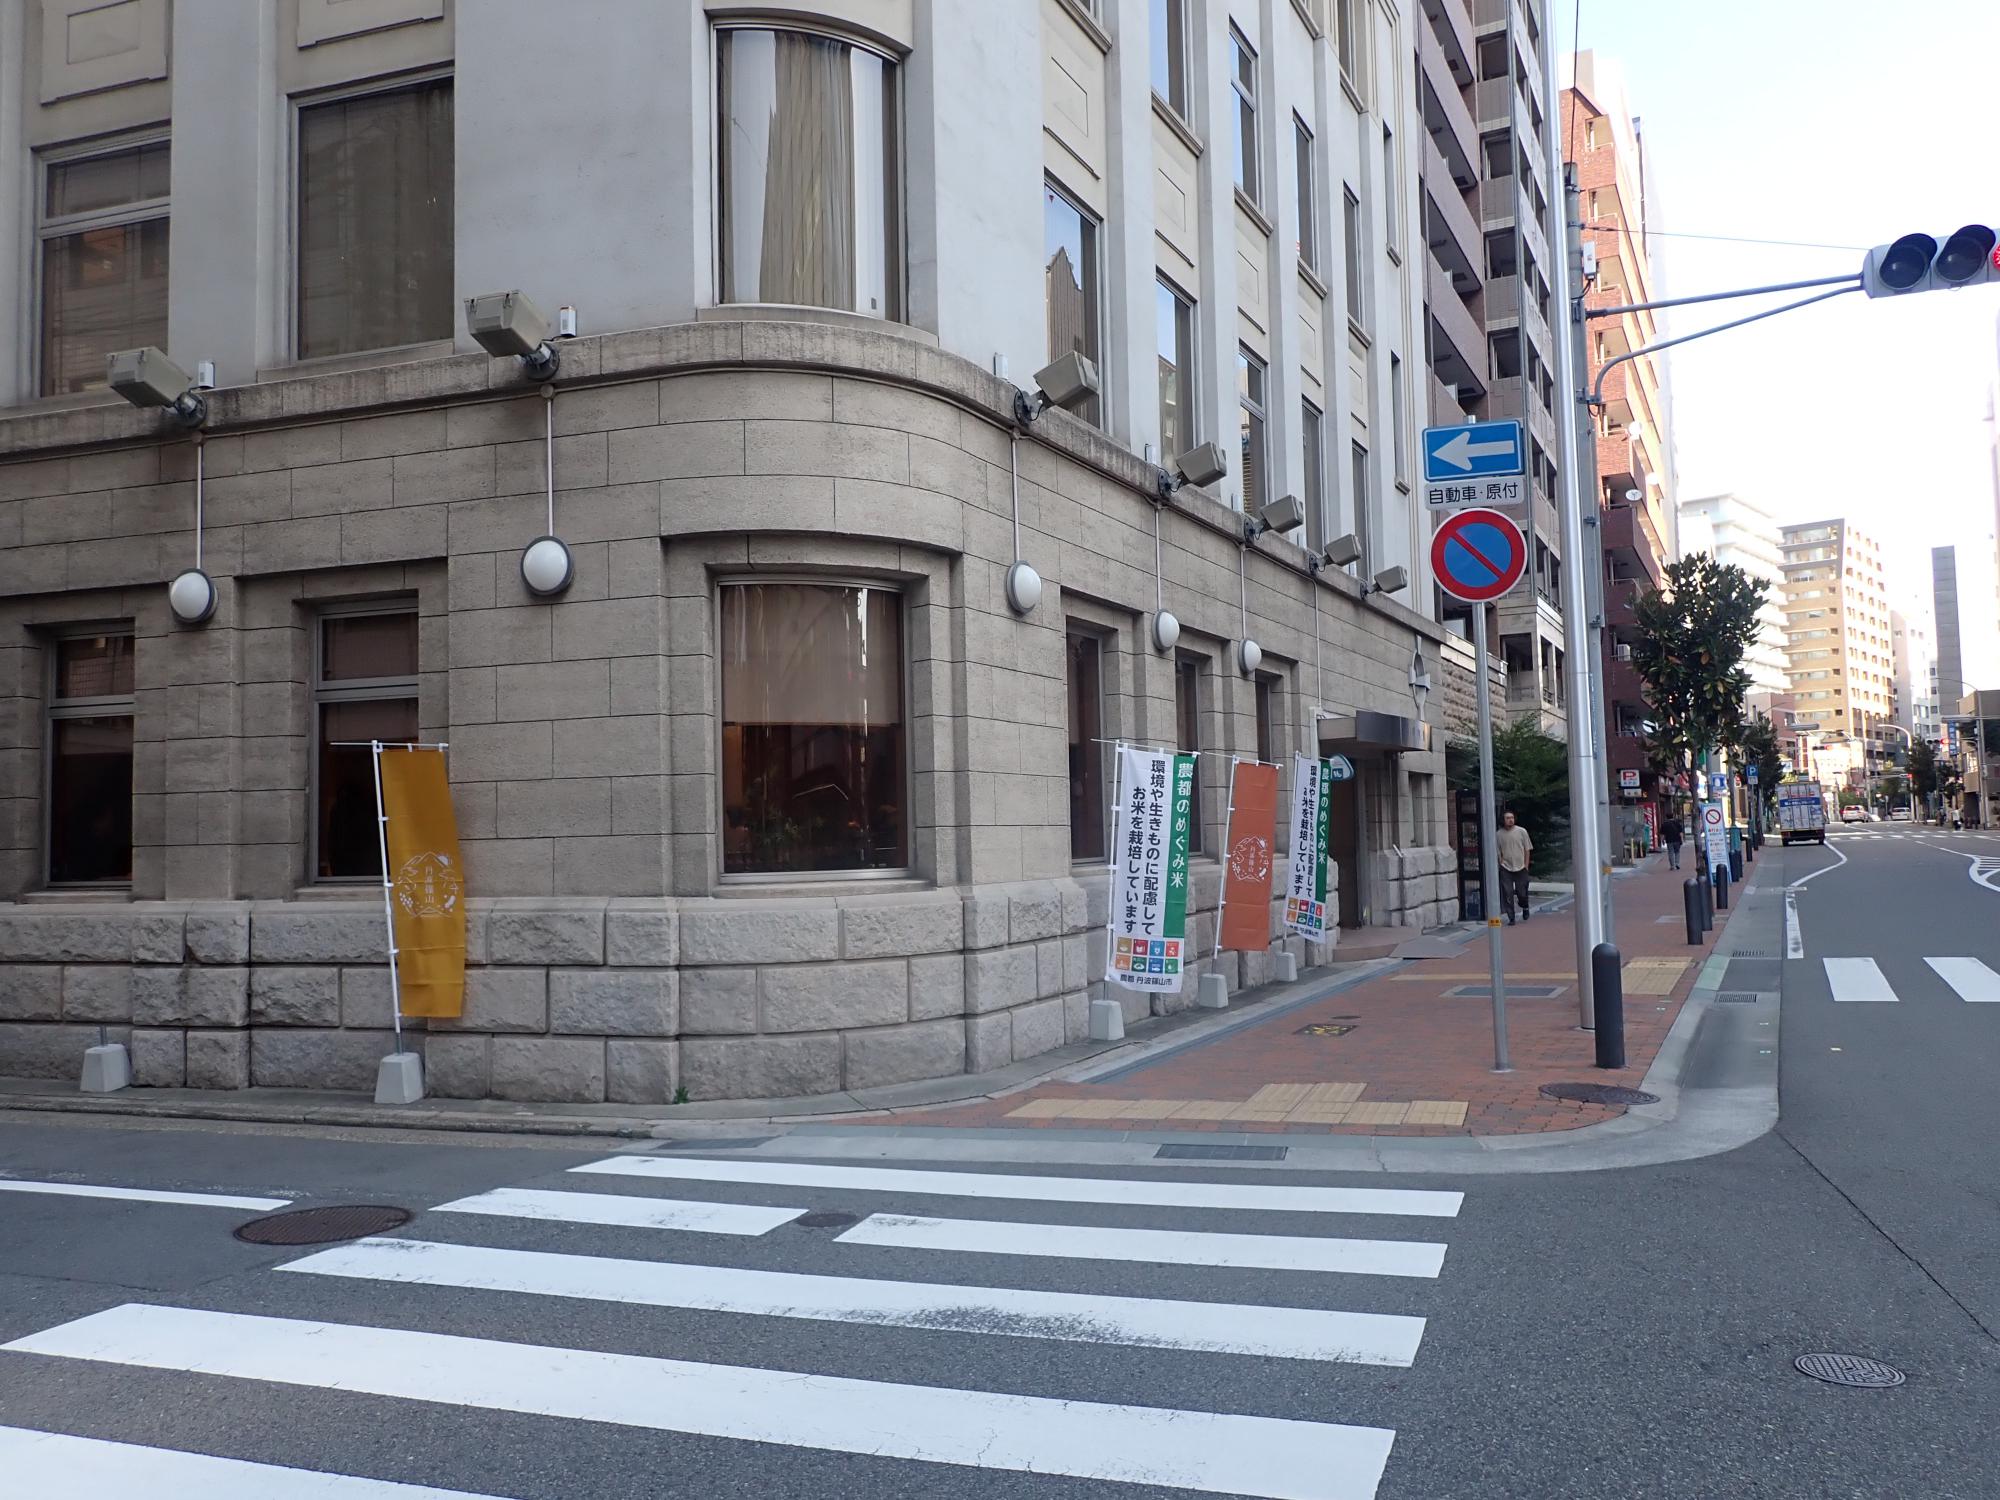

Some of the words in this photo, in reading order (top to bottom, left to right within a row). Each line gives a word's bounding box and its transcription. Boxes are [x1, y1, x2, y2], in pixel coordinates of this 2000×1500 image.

[1429, 482, 1518, 504] 自動車・原付
[1170, 762, 1194, 888] 農都のめぐみ米
[1623, 771, 1637, 781] P
[1124, 786, 1146, 934] お米を栽培しています
[1141, 759, 1165, 935] 環境や生きものに配慮して
